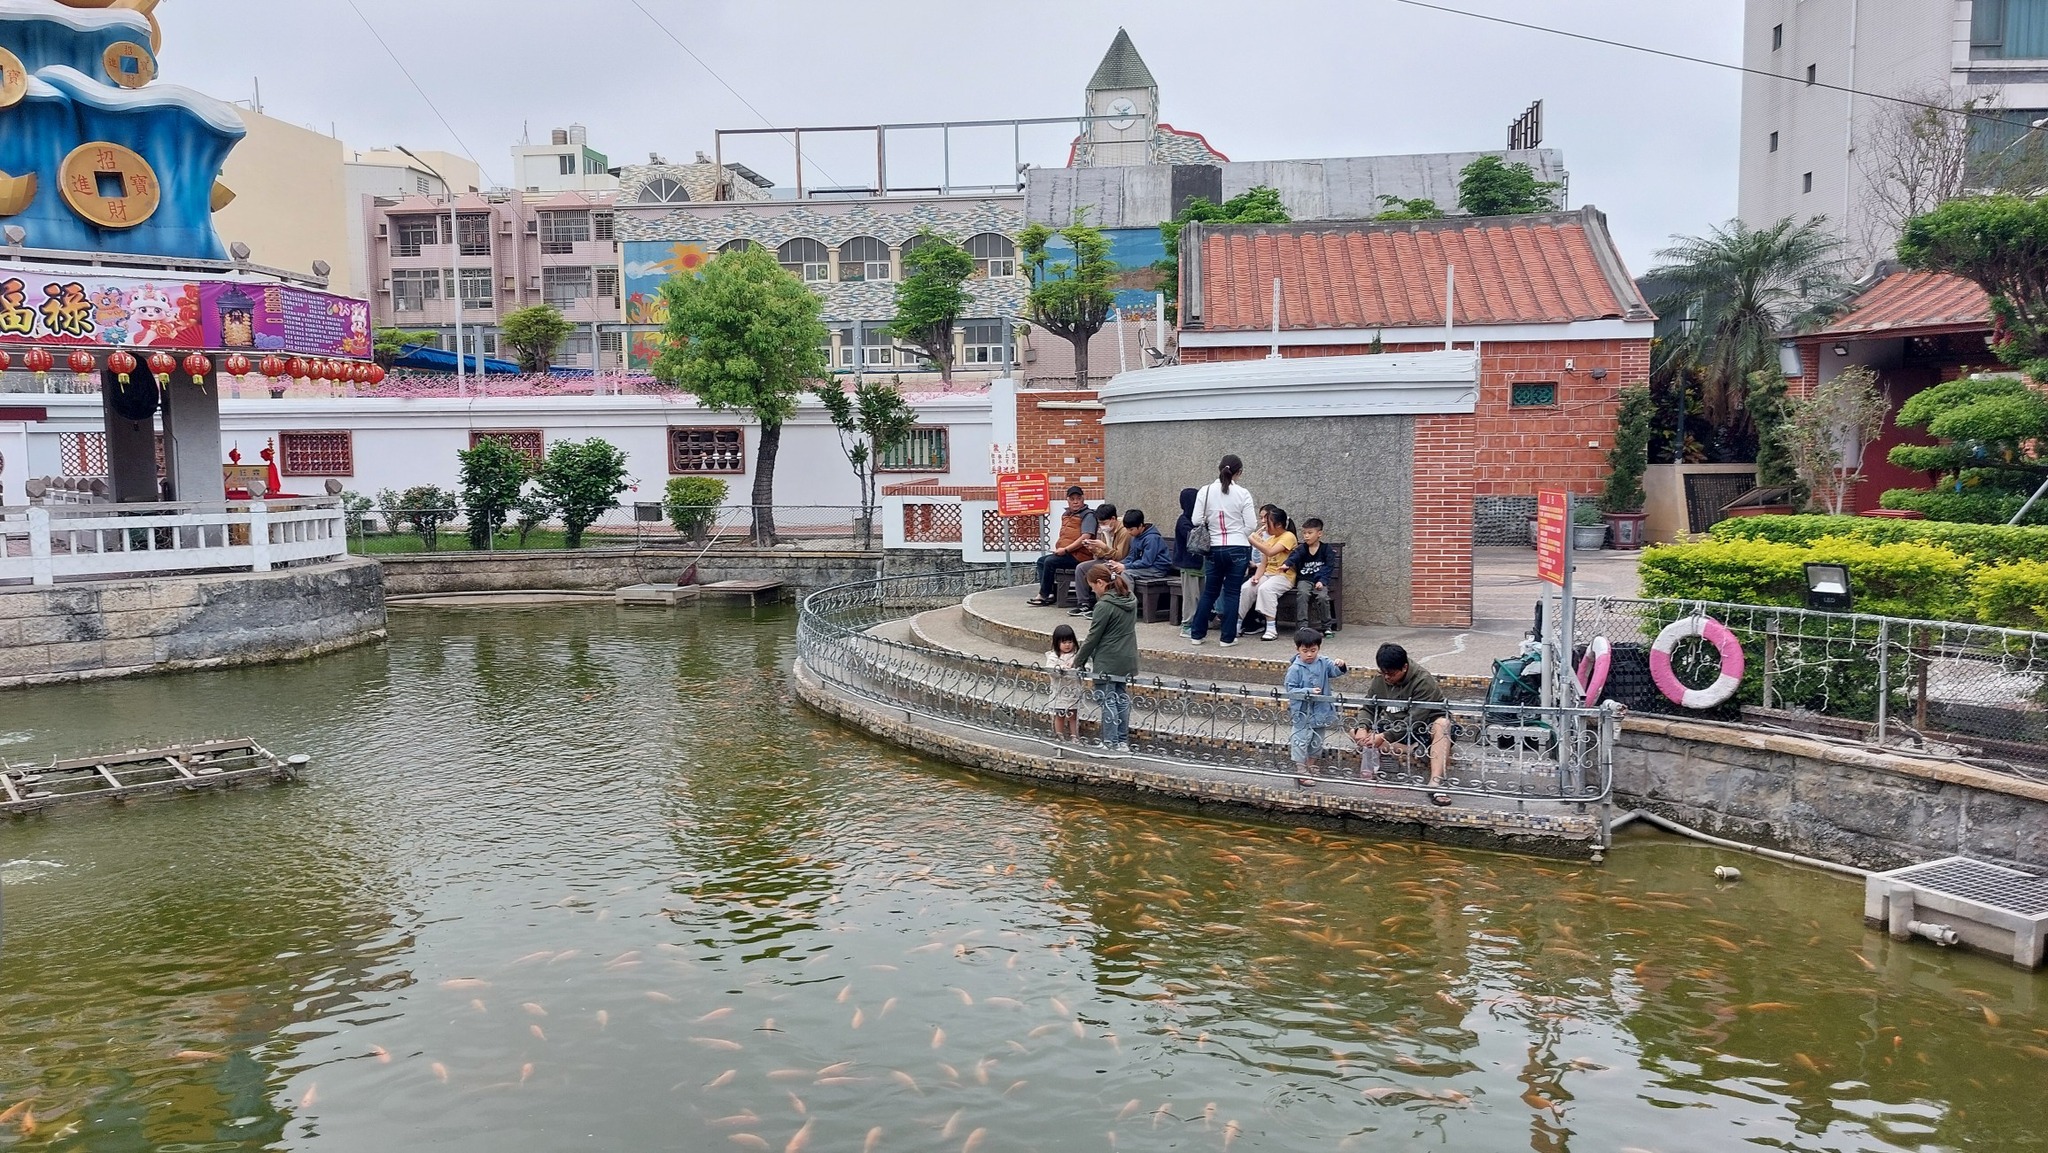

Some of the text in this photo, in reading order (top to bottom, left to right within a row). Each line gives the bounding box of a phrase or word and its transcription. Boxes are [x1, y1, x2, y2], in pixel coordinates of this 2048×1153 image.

[96, 149, 116, 170] 招
[71, 174, 94, 196] 進
[129, 173, 149, 196] 寶
[107, 200, 127, 221] 財
